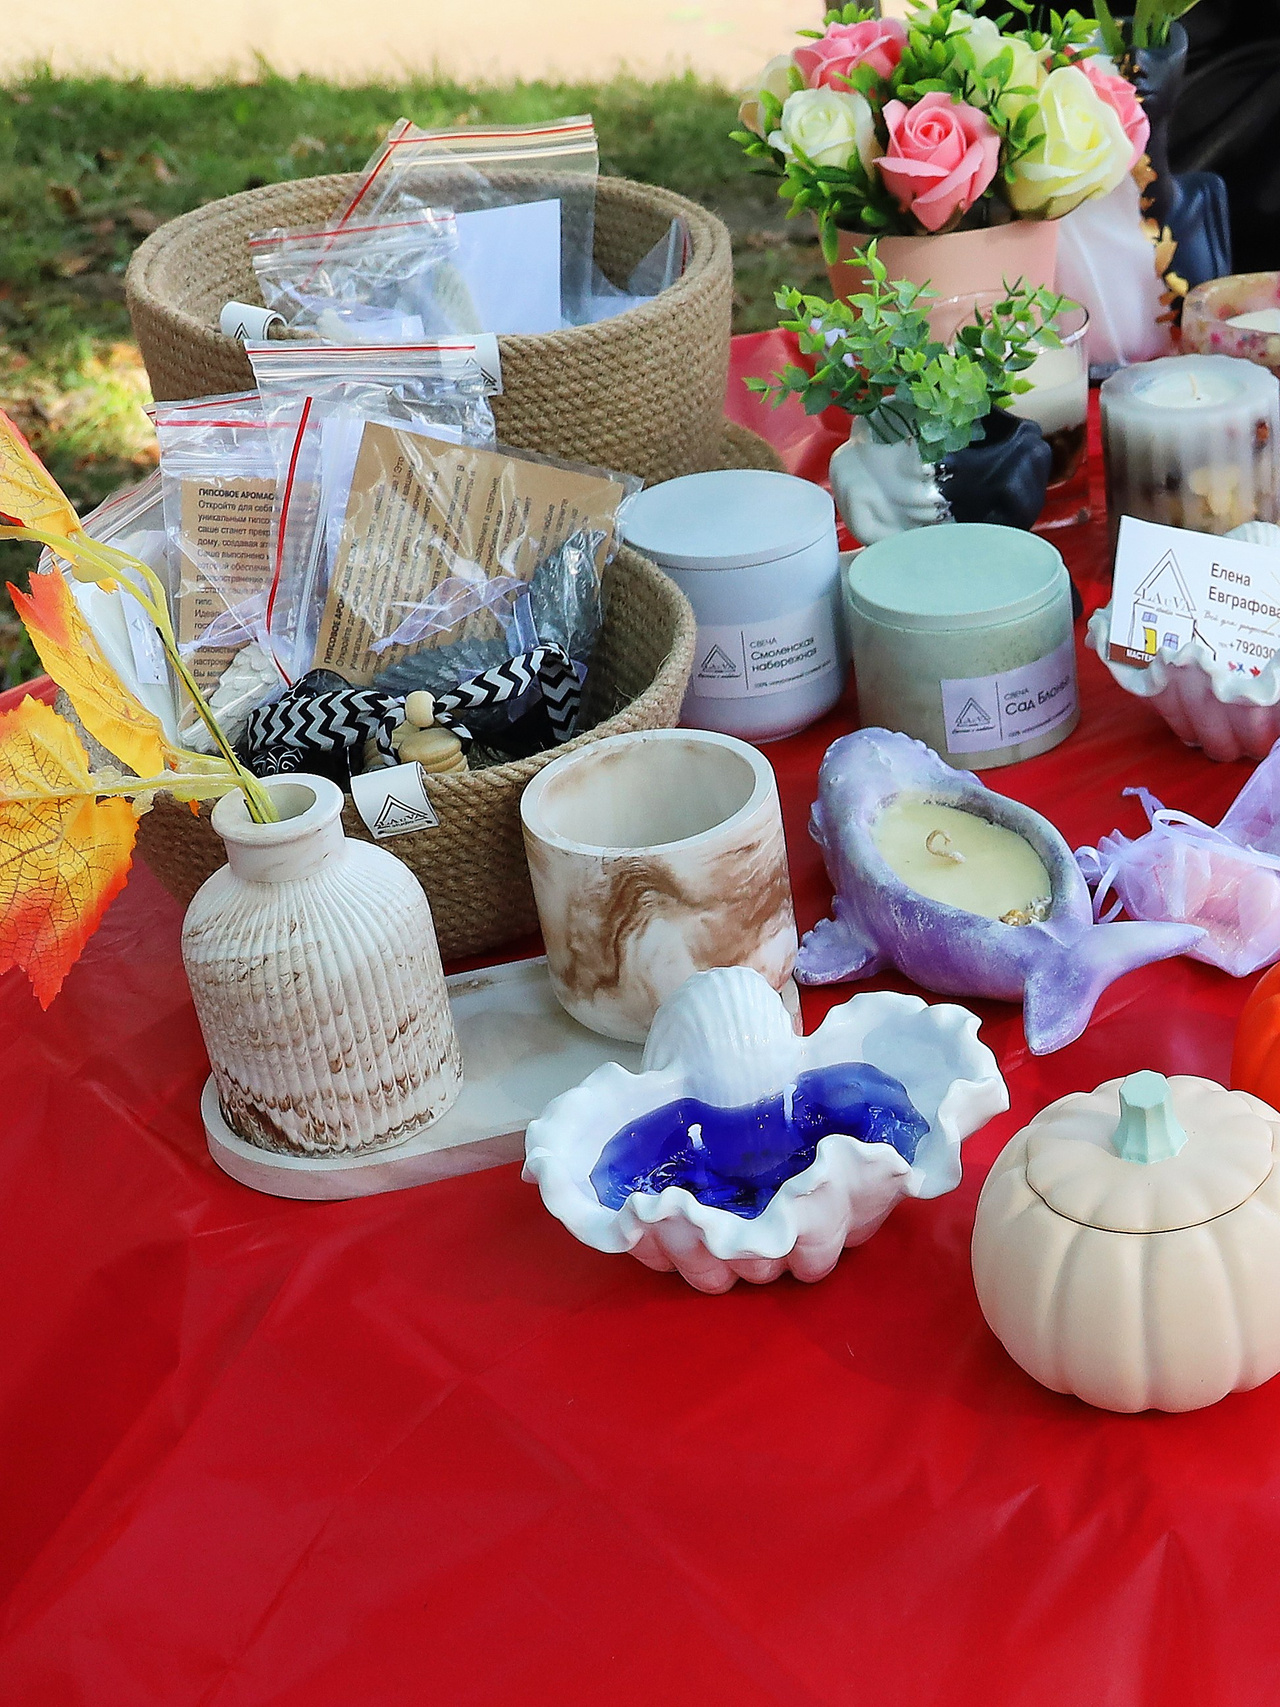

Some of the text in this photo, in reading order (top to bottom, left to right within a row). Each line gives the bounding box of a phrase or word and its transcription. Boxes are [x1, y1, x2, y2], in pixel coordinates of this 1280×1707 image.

[1210, 563, 1251, 587] Елена
[751, 636, 815, 661] Смоленская
[752, 647, 817, 672] набережная
[1005, 699, 1036, 716] Сад
